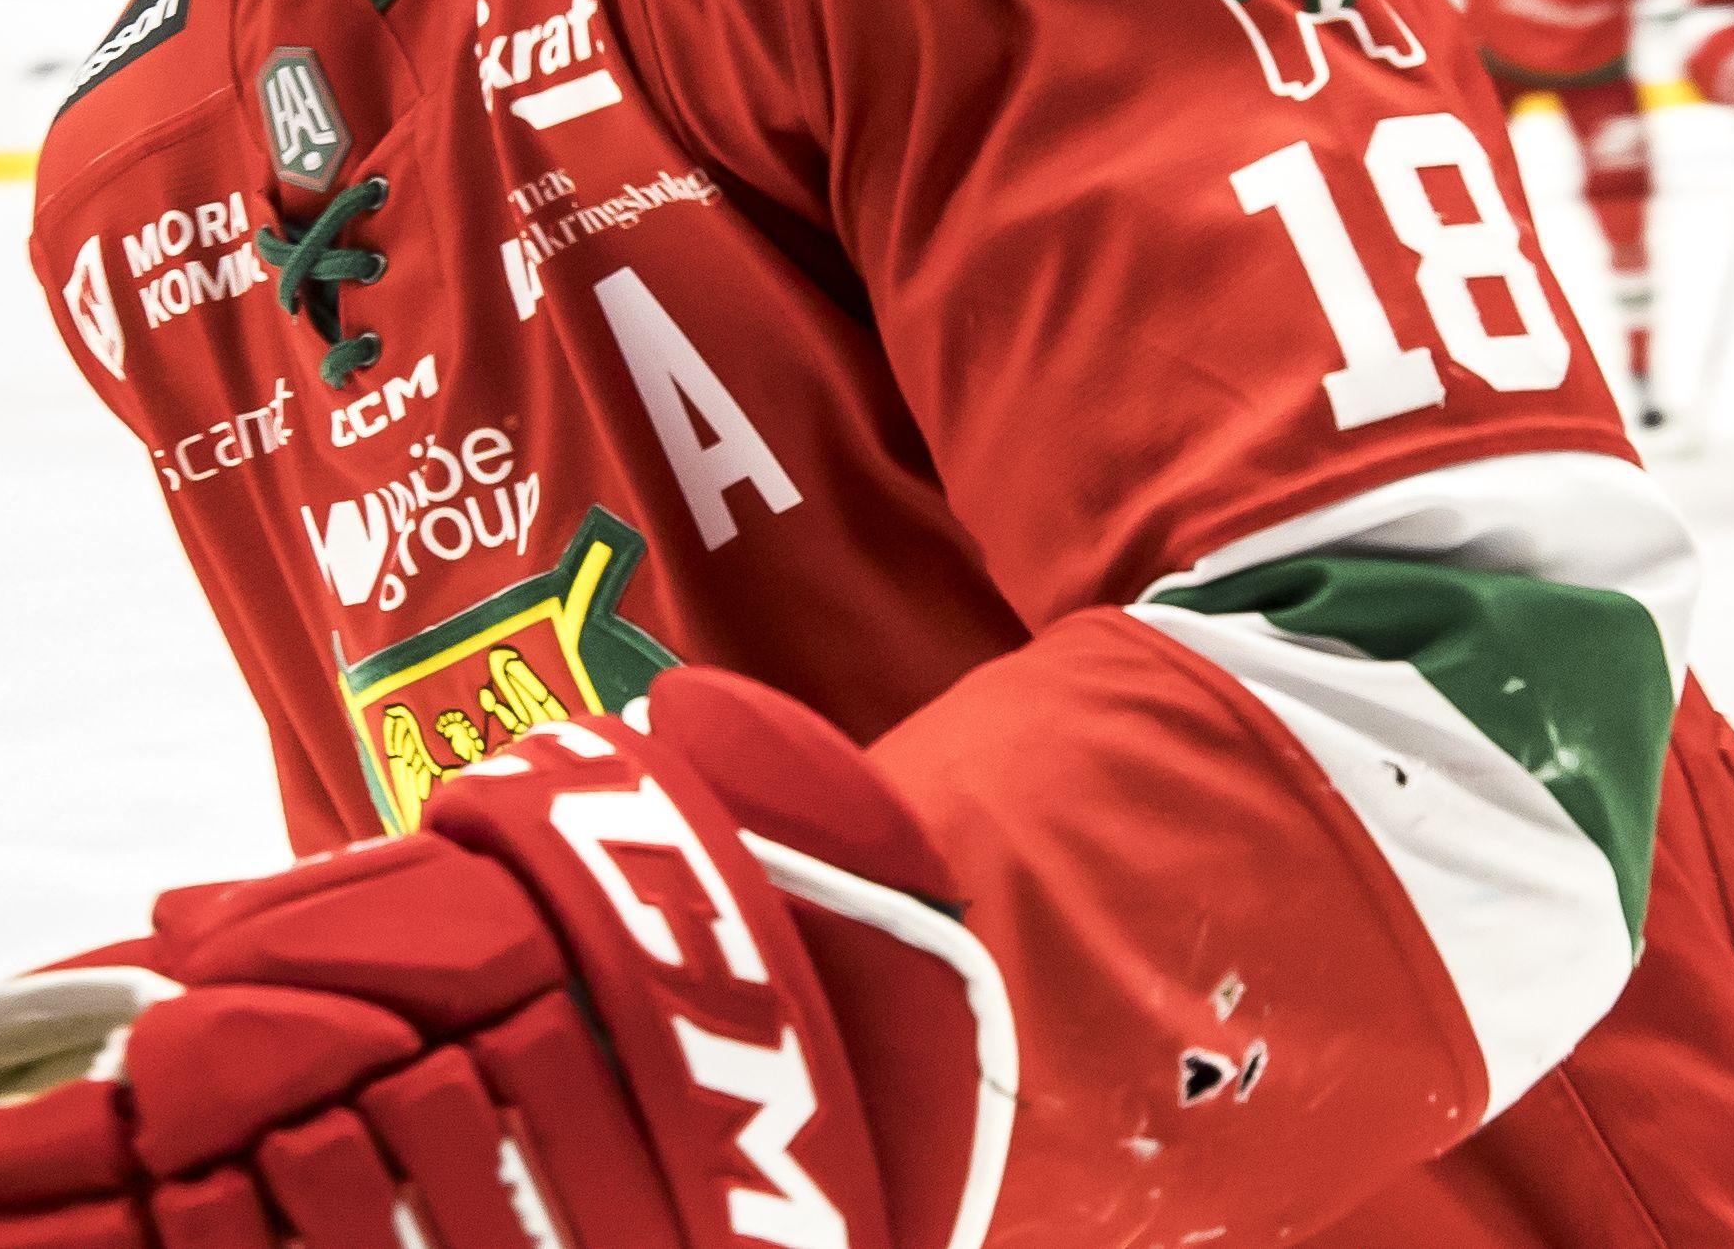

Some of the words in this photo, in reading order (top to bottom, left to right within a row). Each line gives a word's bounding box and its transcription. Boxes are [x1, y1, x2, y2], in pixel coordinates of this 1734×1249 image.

[122, 191, 250, 278] MORA
[1228, 112, 1571, 432] 18
[330, 353, 440, 448] CCM
[592, 265, 804, 551] A
